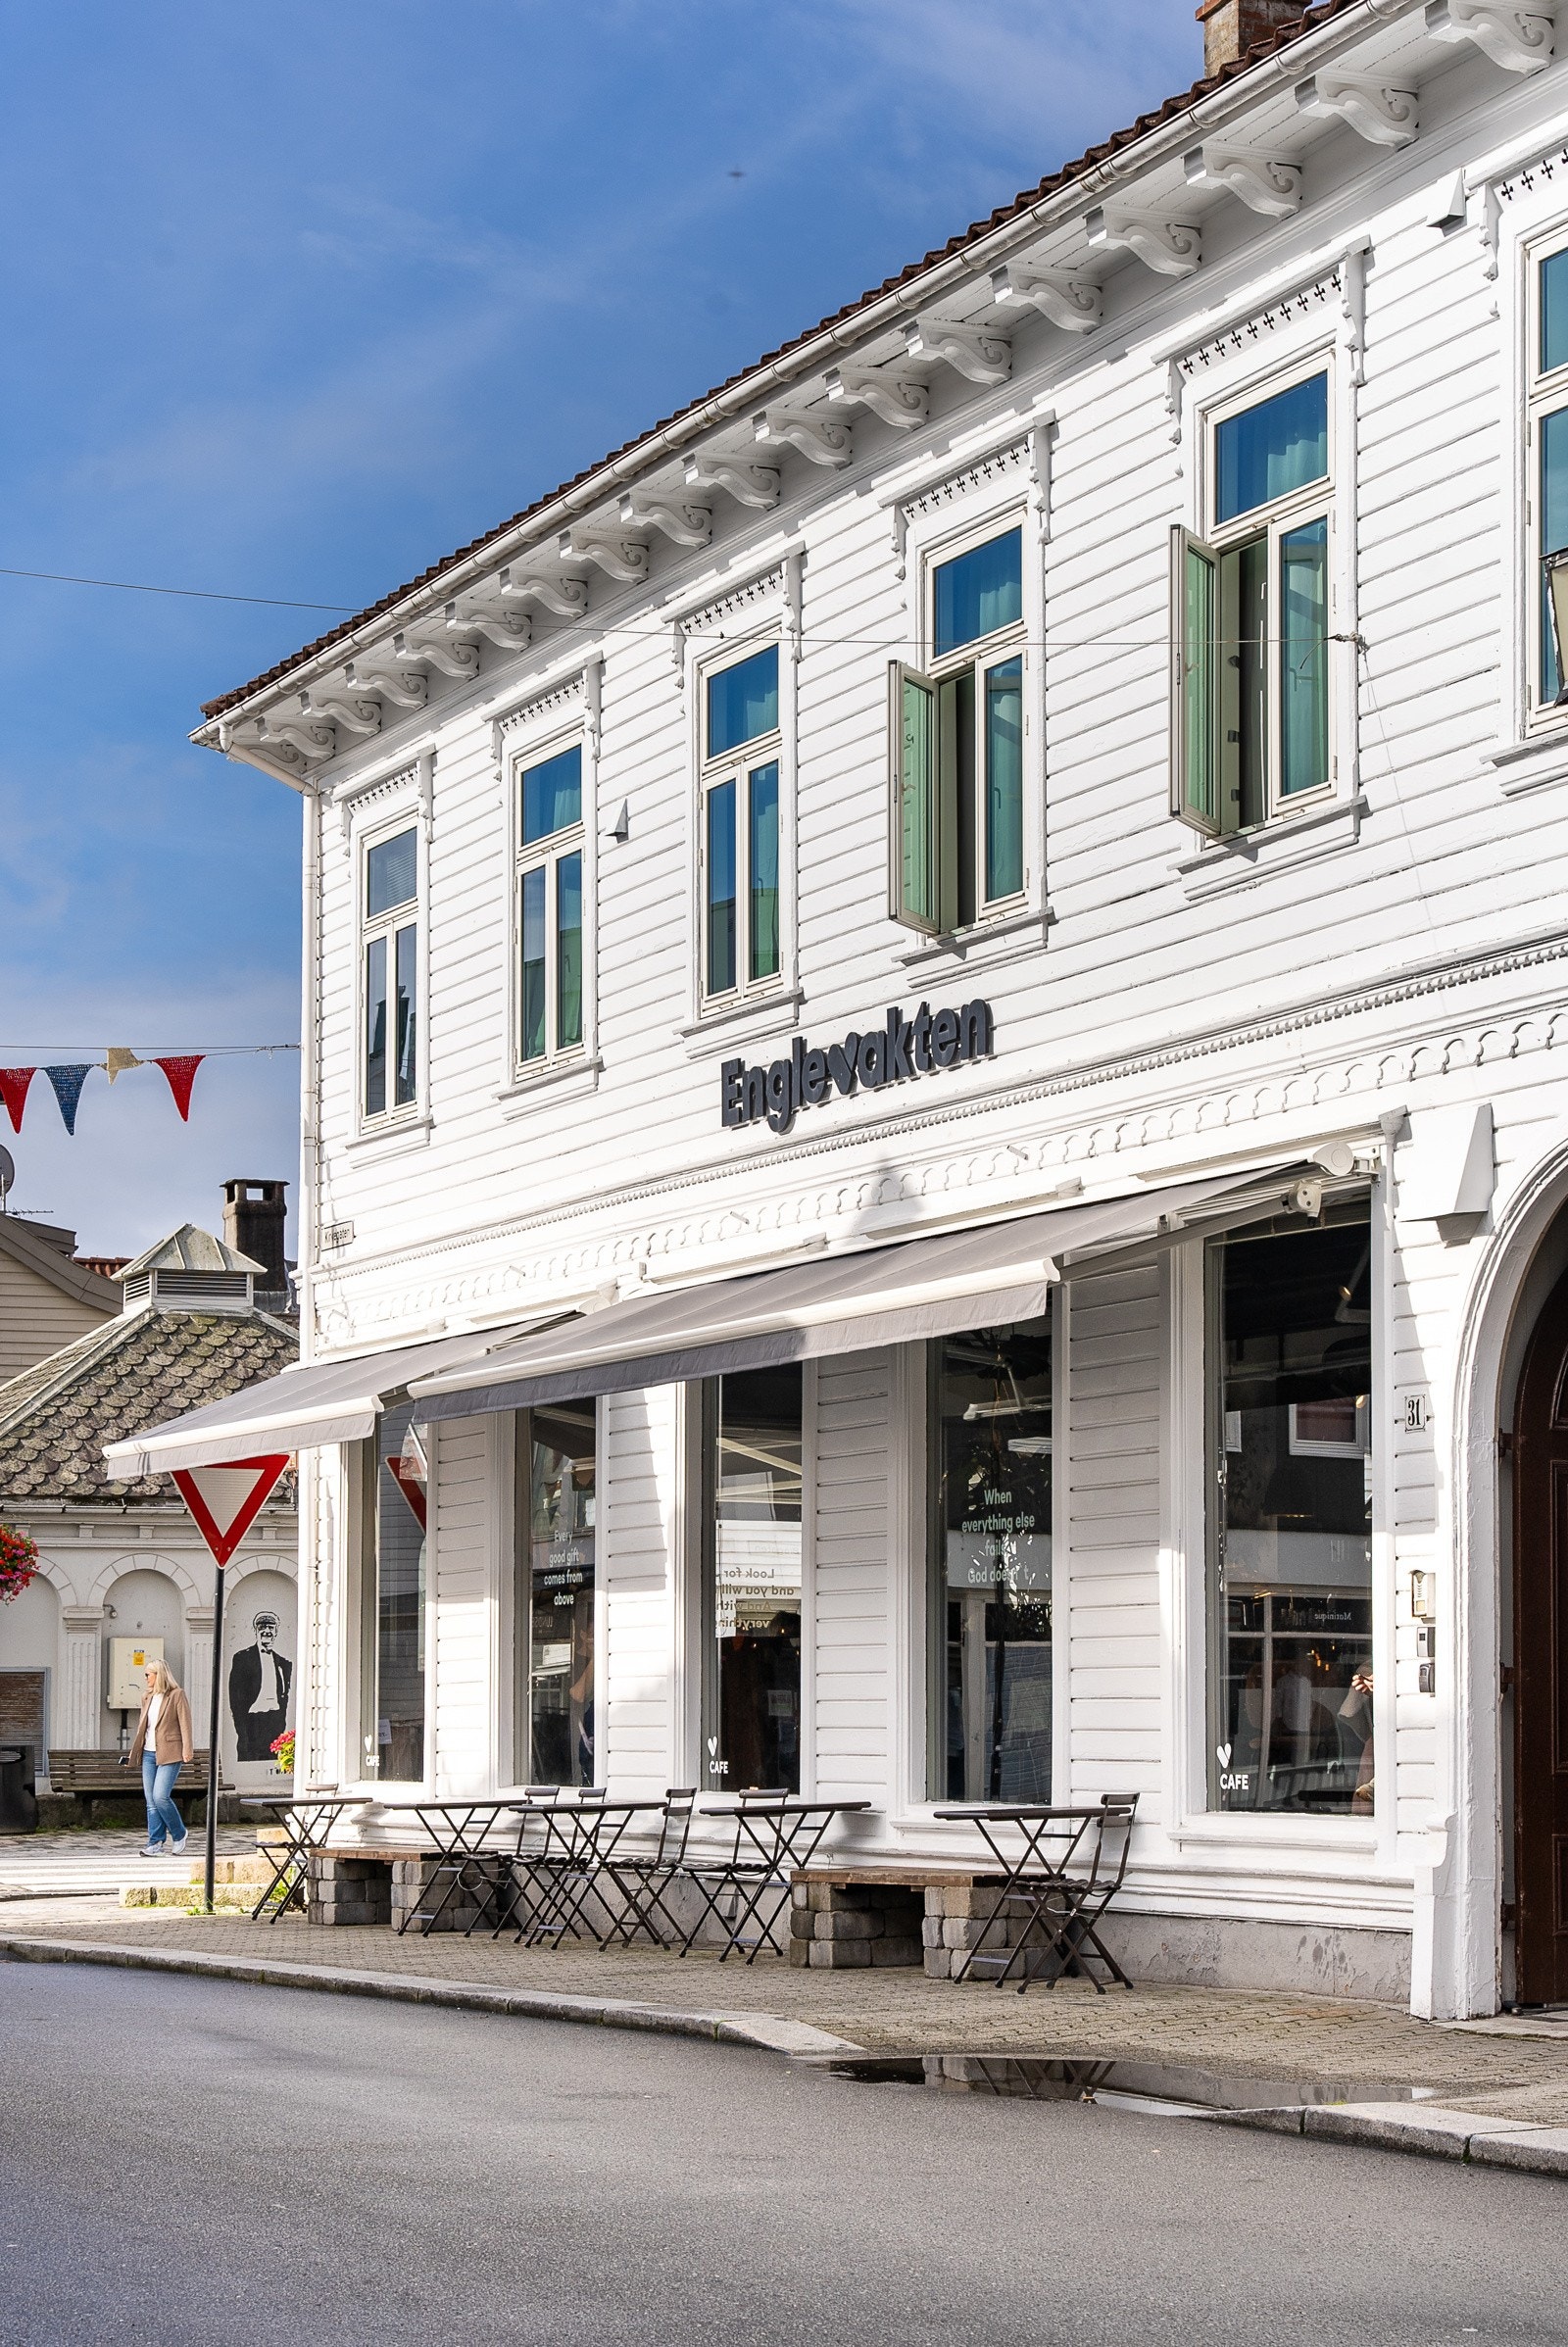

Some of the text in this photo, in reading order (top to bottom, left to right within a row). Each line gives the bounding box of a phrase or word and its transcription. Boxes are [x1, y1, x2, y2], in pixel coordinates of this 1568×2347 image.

[721, 998, 992, 1134] Englevakten
[1408, 1398, 1421, 1426] 31
[984, 1489, 1012, 1505] When
[962, 1511, 1036, 1536] everything else
[554, 1530, 572, 1545] Every
[549, 1547, 579, 1567] good gift
[544, 1569, 583, 1586] comes from
[968, 1565, 1029, 1584] God doesnt
[554, 1591, 574, 1605] above
[366, 1755, 380, 1767] CAFE
[710, 1760, 729, 1774] CAFE
[1220, 1774, 1249, 1789] CAFE
